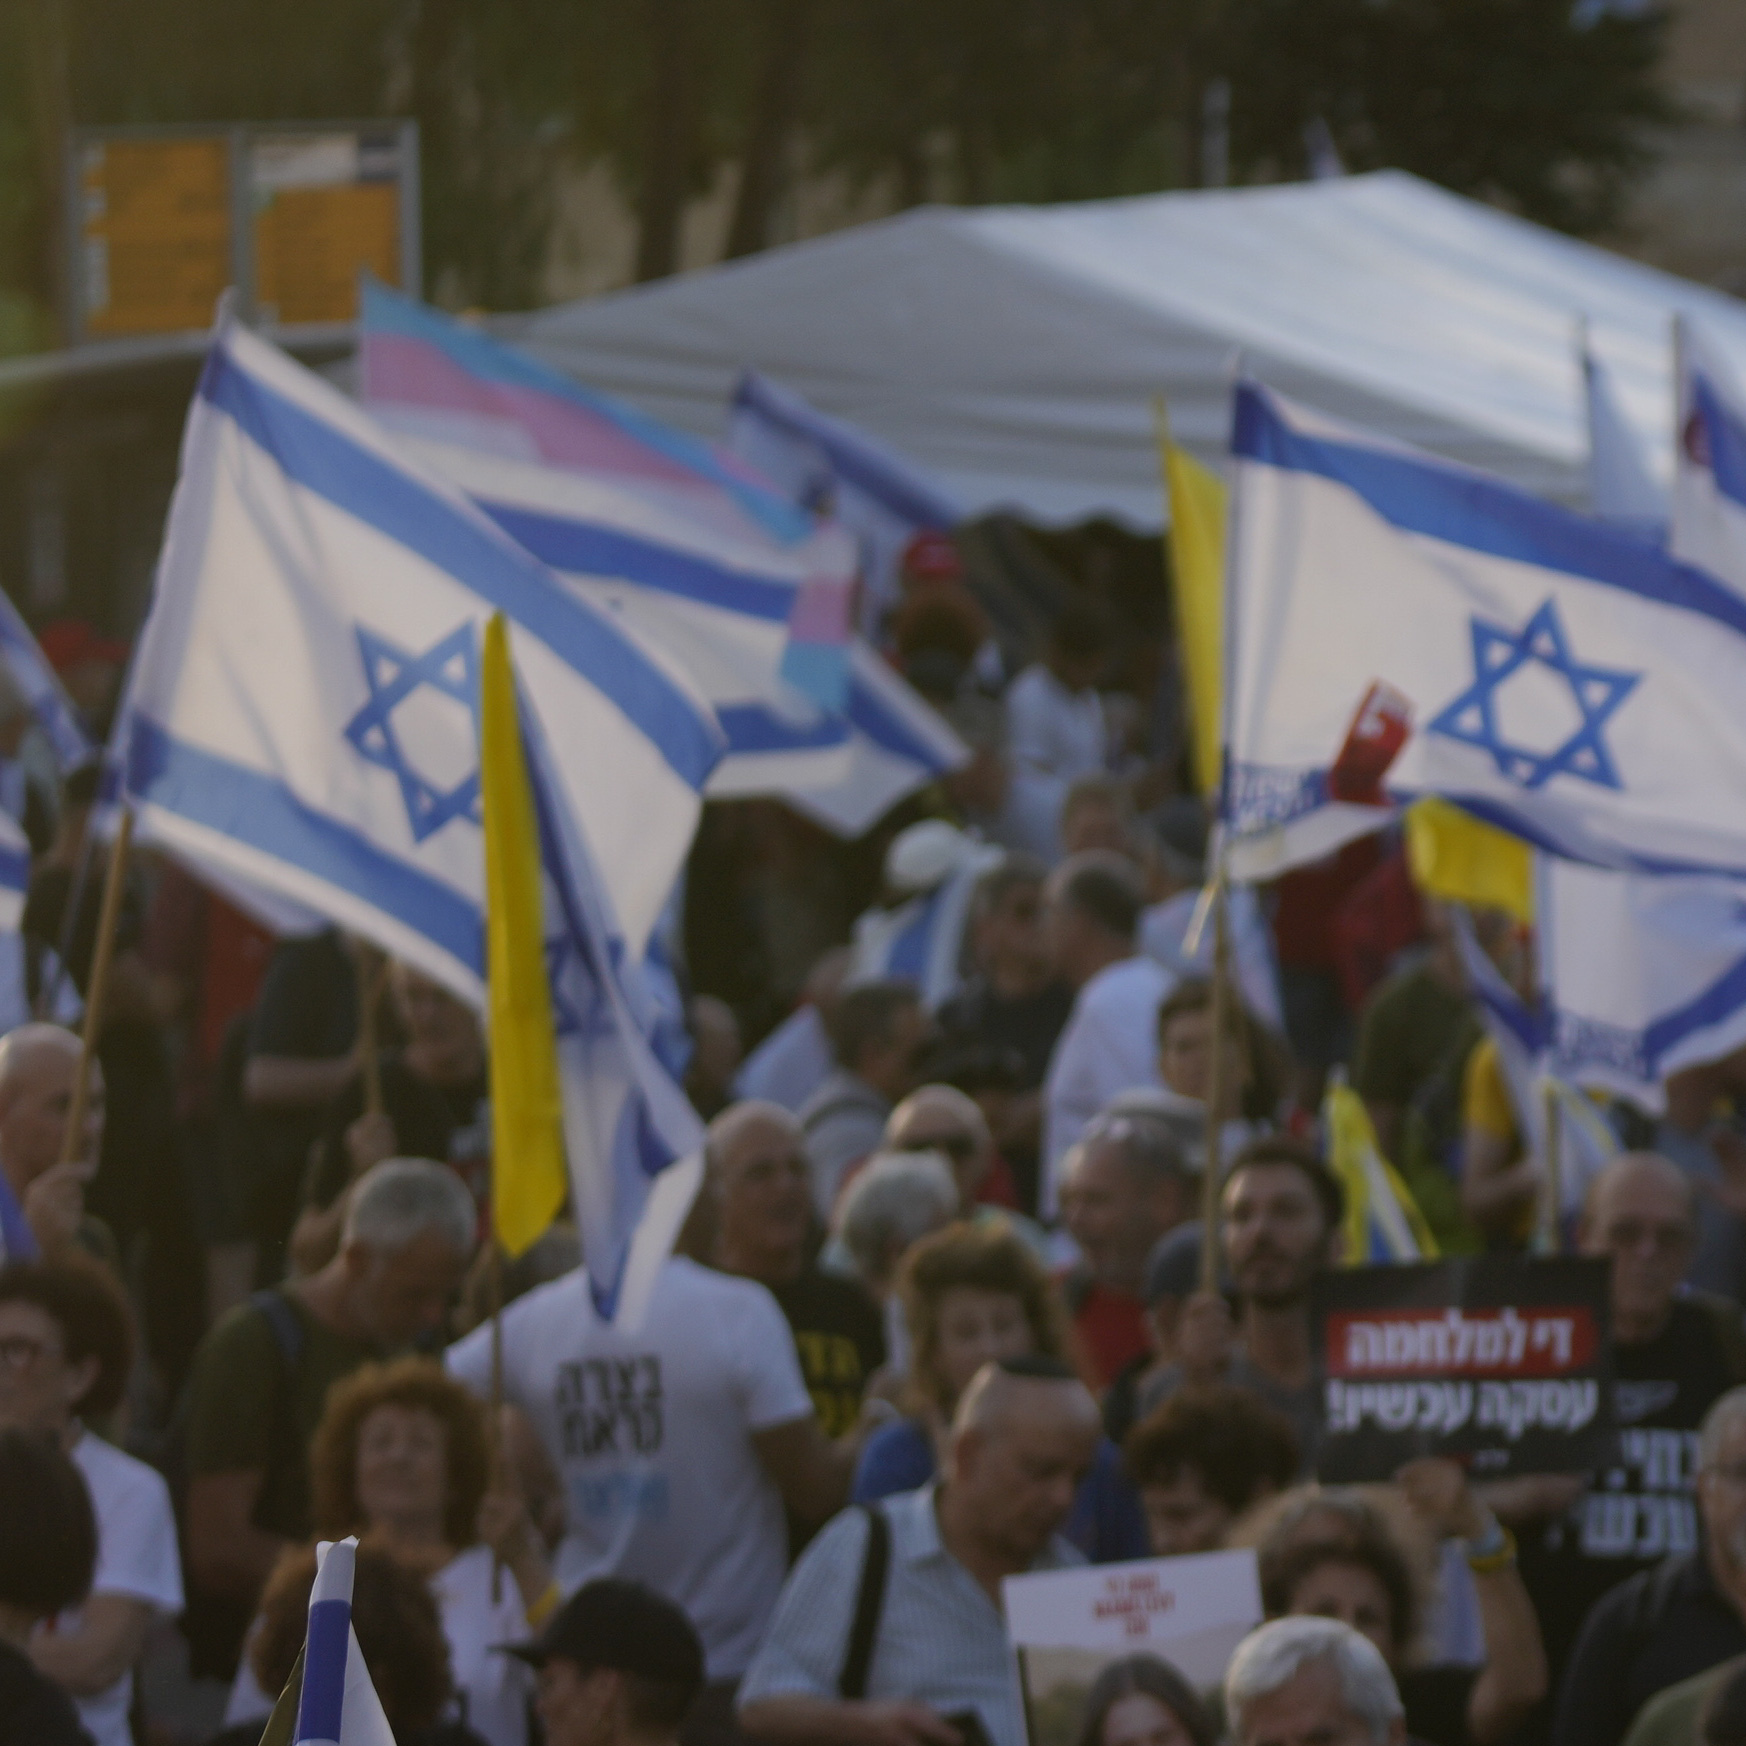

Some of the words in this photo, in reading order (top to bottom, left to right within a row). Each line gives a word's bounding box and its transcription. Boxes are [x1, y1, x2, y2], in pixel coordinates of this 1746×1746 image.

[1345, 1305, 1529, 1370] למלחמה
[1530, 1315, 1576, 1368] די
[1324, 1378, 1475, 1434] עכשיו!
[1475, 1378, 1600, 1440] עסקה
